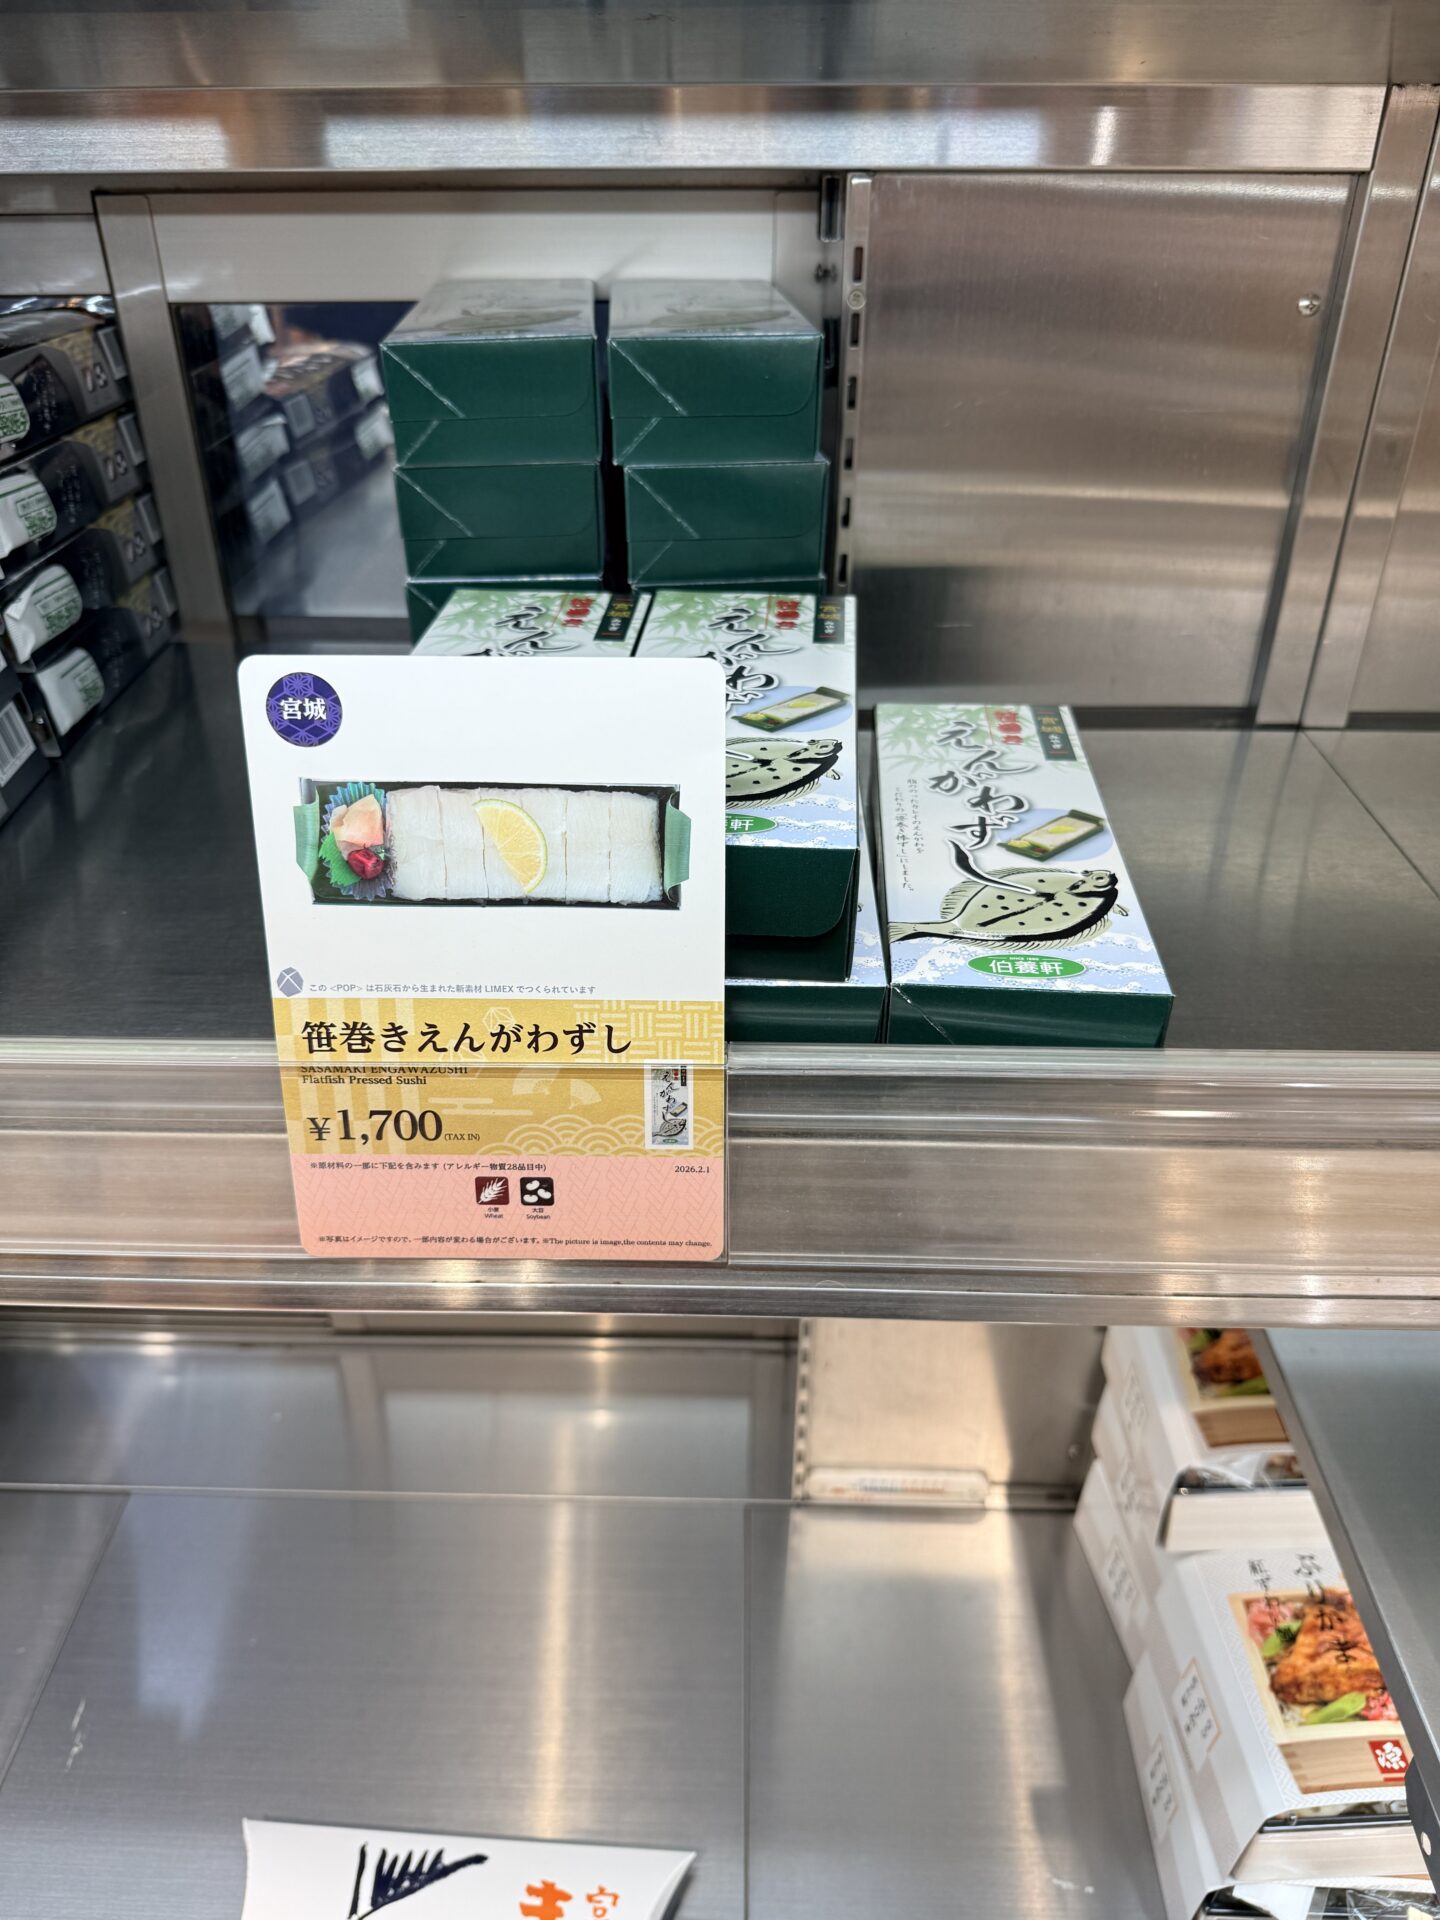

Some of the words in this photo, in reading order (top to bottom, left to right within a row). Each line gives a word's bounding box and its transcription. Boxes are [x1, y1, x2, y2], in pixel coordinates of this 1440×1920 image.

[280, 698, 327, 720] 宮城
[989, 960, 1064, 975] 伯養軒
[309, 984, 328, 992] この
[330, 984, 362, 992] <POP>
[366, 984, 481, 993] は石灰石から生まれた新素材
[485, 985, 513, 993] LIMEX
[516, 985, 596, 994] でつくられています
[301, 1021, 631, 1055] 笹巻きえんがわずし
[301, 1066, 367, 1074] SASAMAKI
[302, 1075, 345, 1084] Flatfish
[350, 1076, 392, 1085] Pressed
[396, 1076, 427, 1085] Sushi
[307, 1109, 442, 1145] ¥1,700
[674, 1165, 710, 1174] 2026.2.1
[565, 1238, 590, 1246] picture
[668, 1240, 683, 1248] may
[685, 1240, 712, 1248] change.
